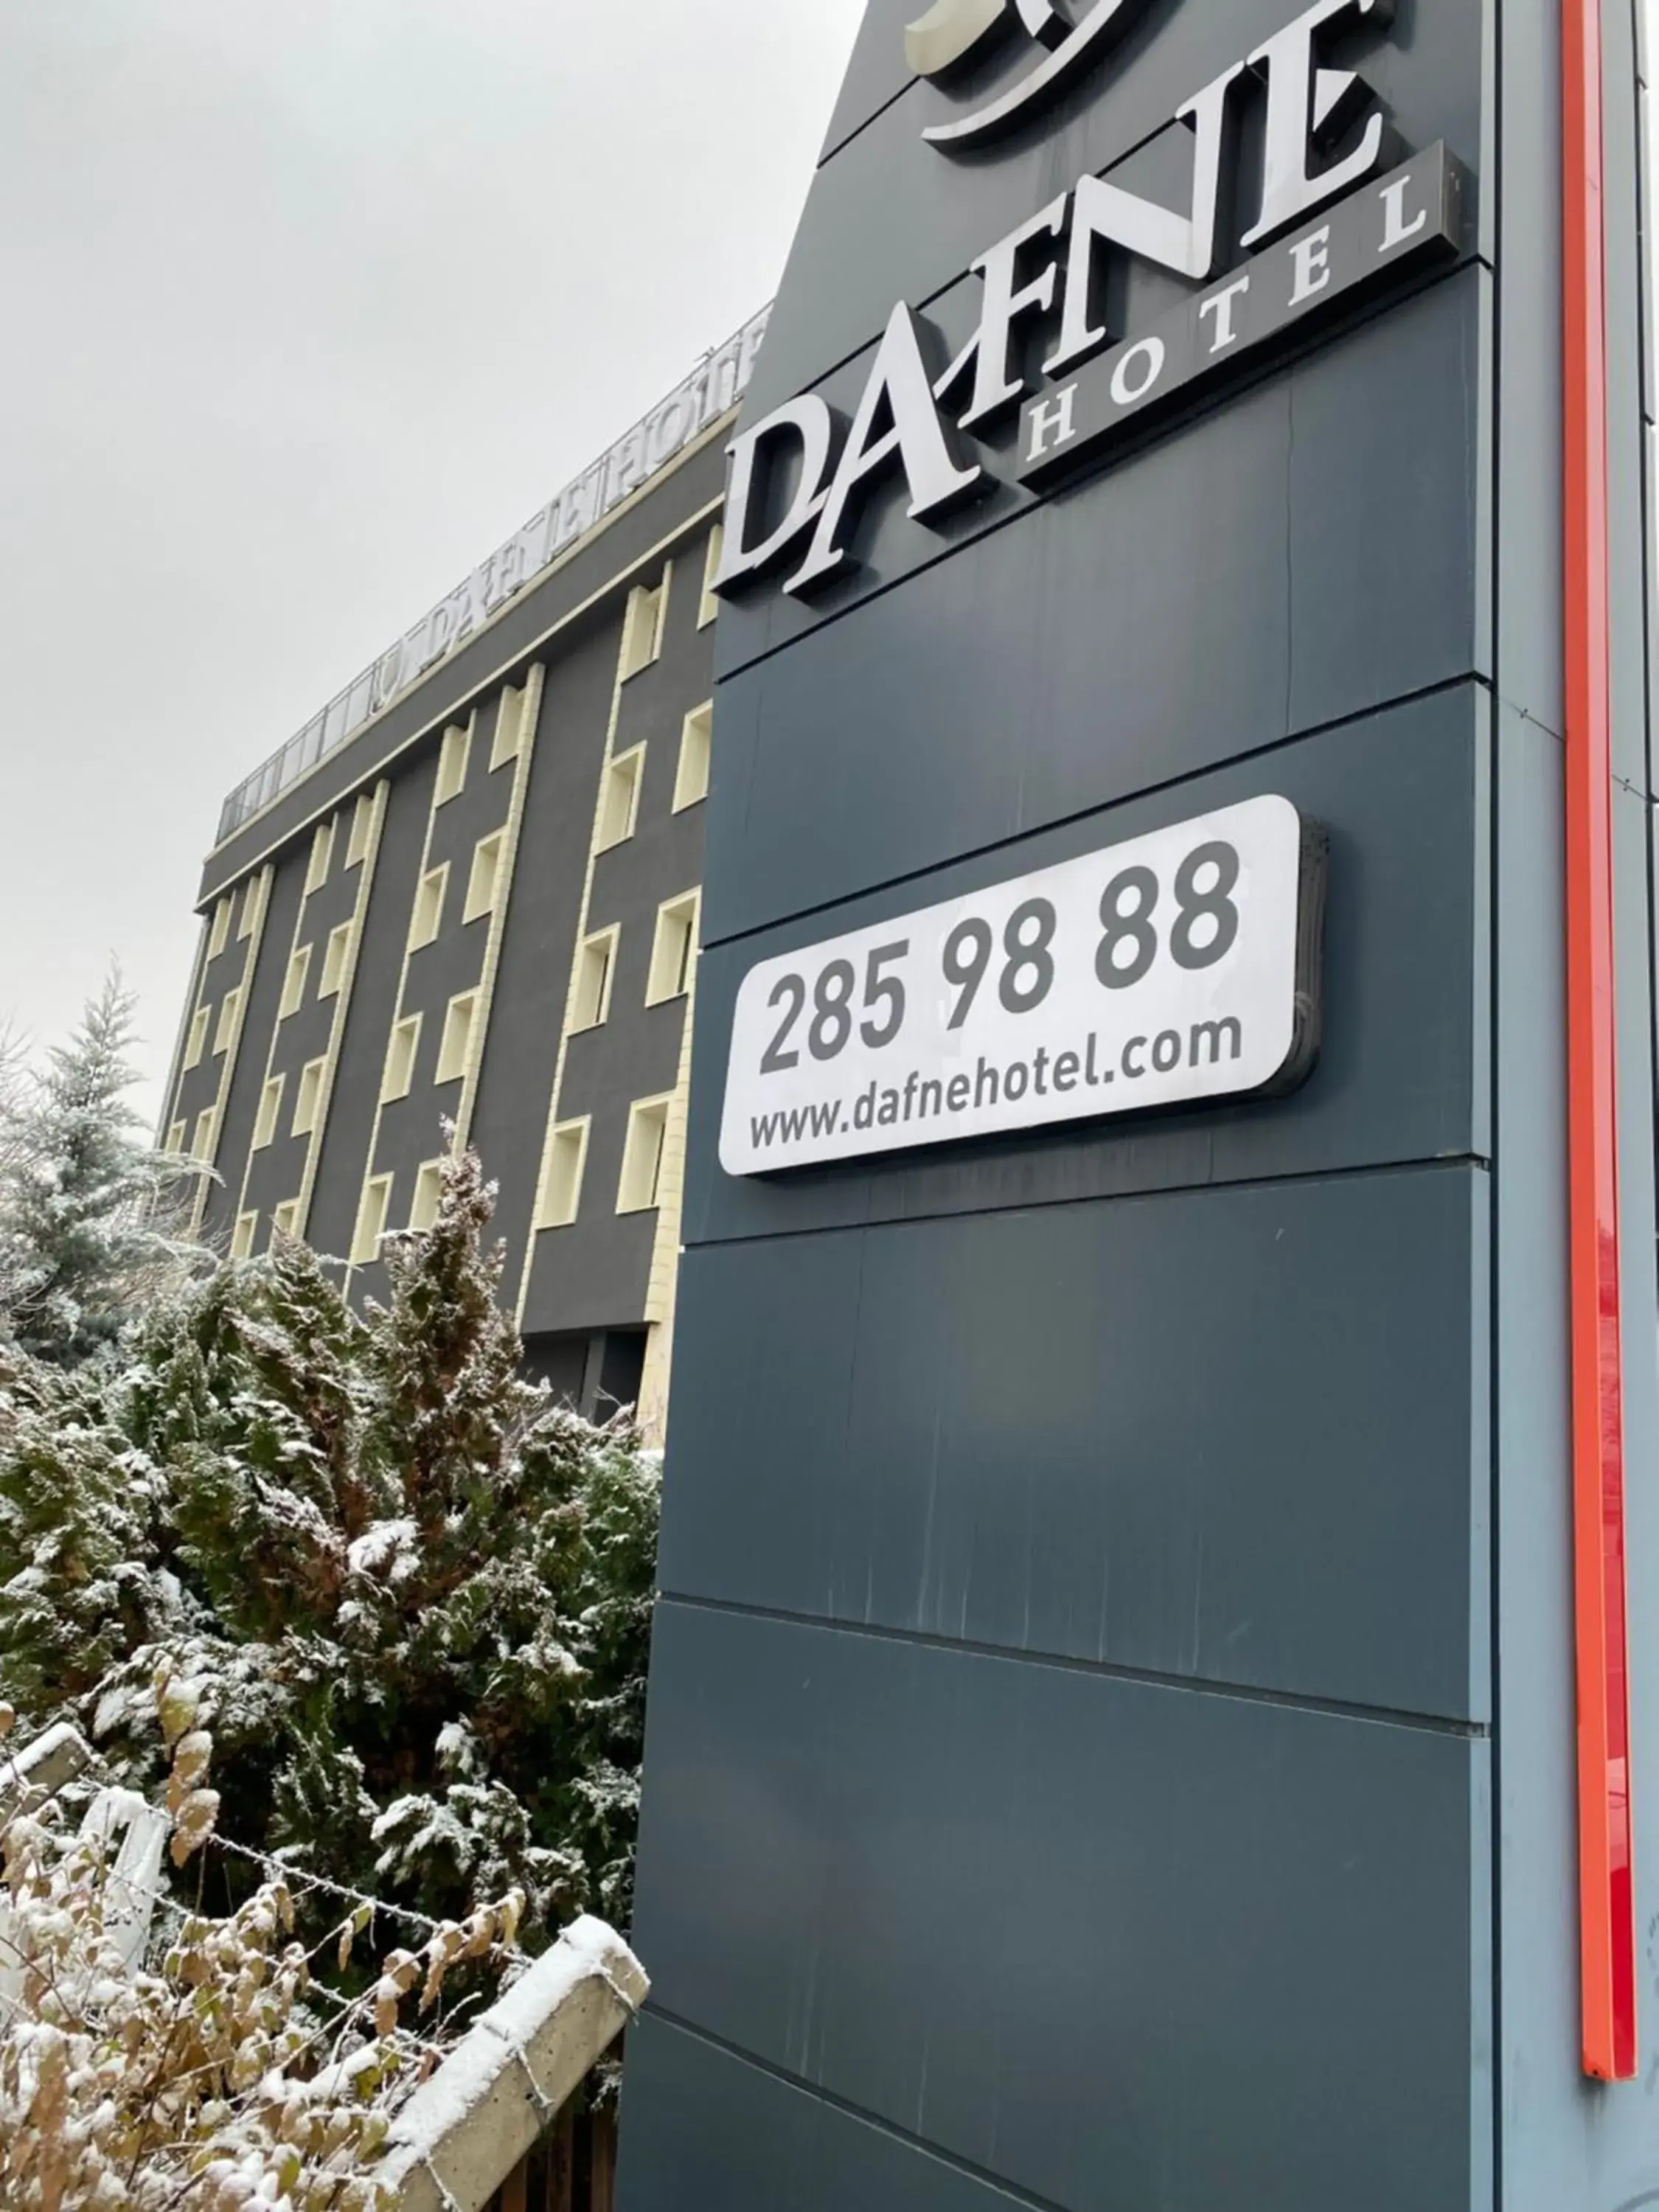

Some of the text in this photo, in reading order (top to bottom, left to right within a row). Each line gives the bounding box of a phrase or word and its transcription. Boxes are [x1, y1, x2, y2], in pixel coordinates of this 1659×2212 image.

[709, 0, 1382, 594] DAFNE
[1026, 175, 1426, 462] HOTEL
[750, 1015, 1242, 1149] www.dafnehotel.com
[759, 841, 1239, 1075] 285 98 88
